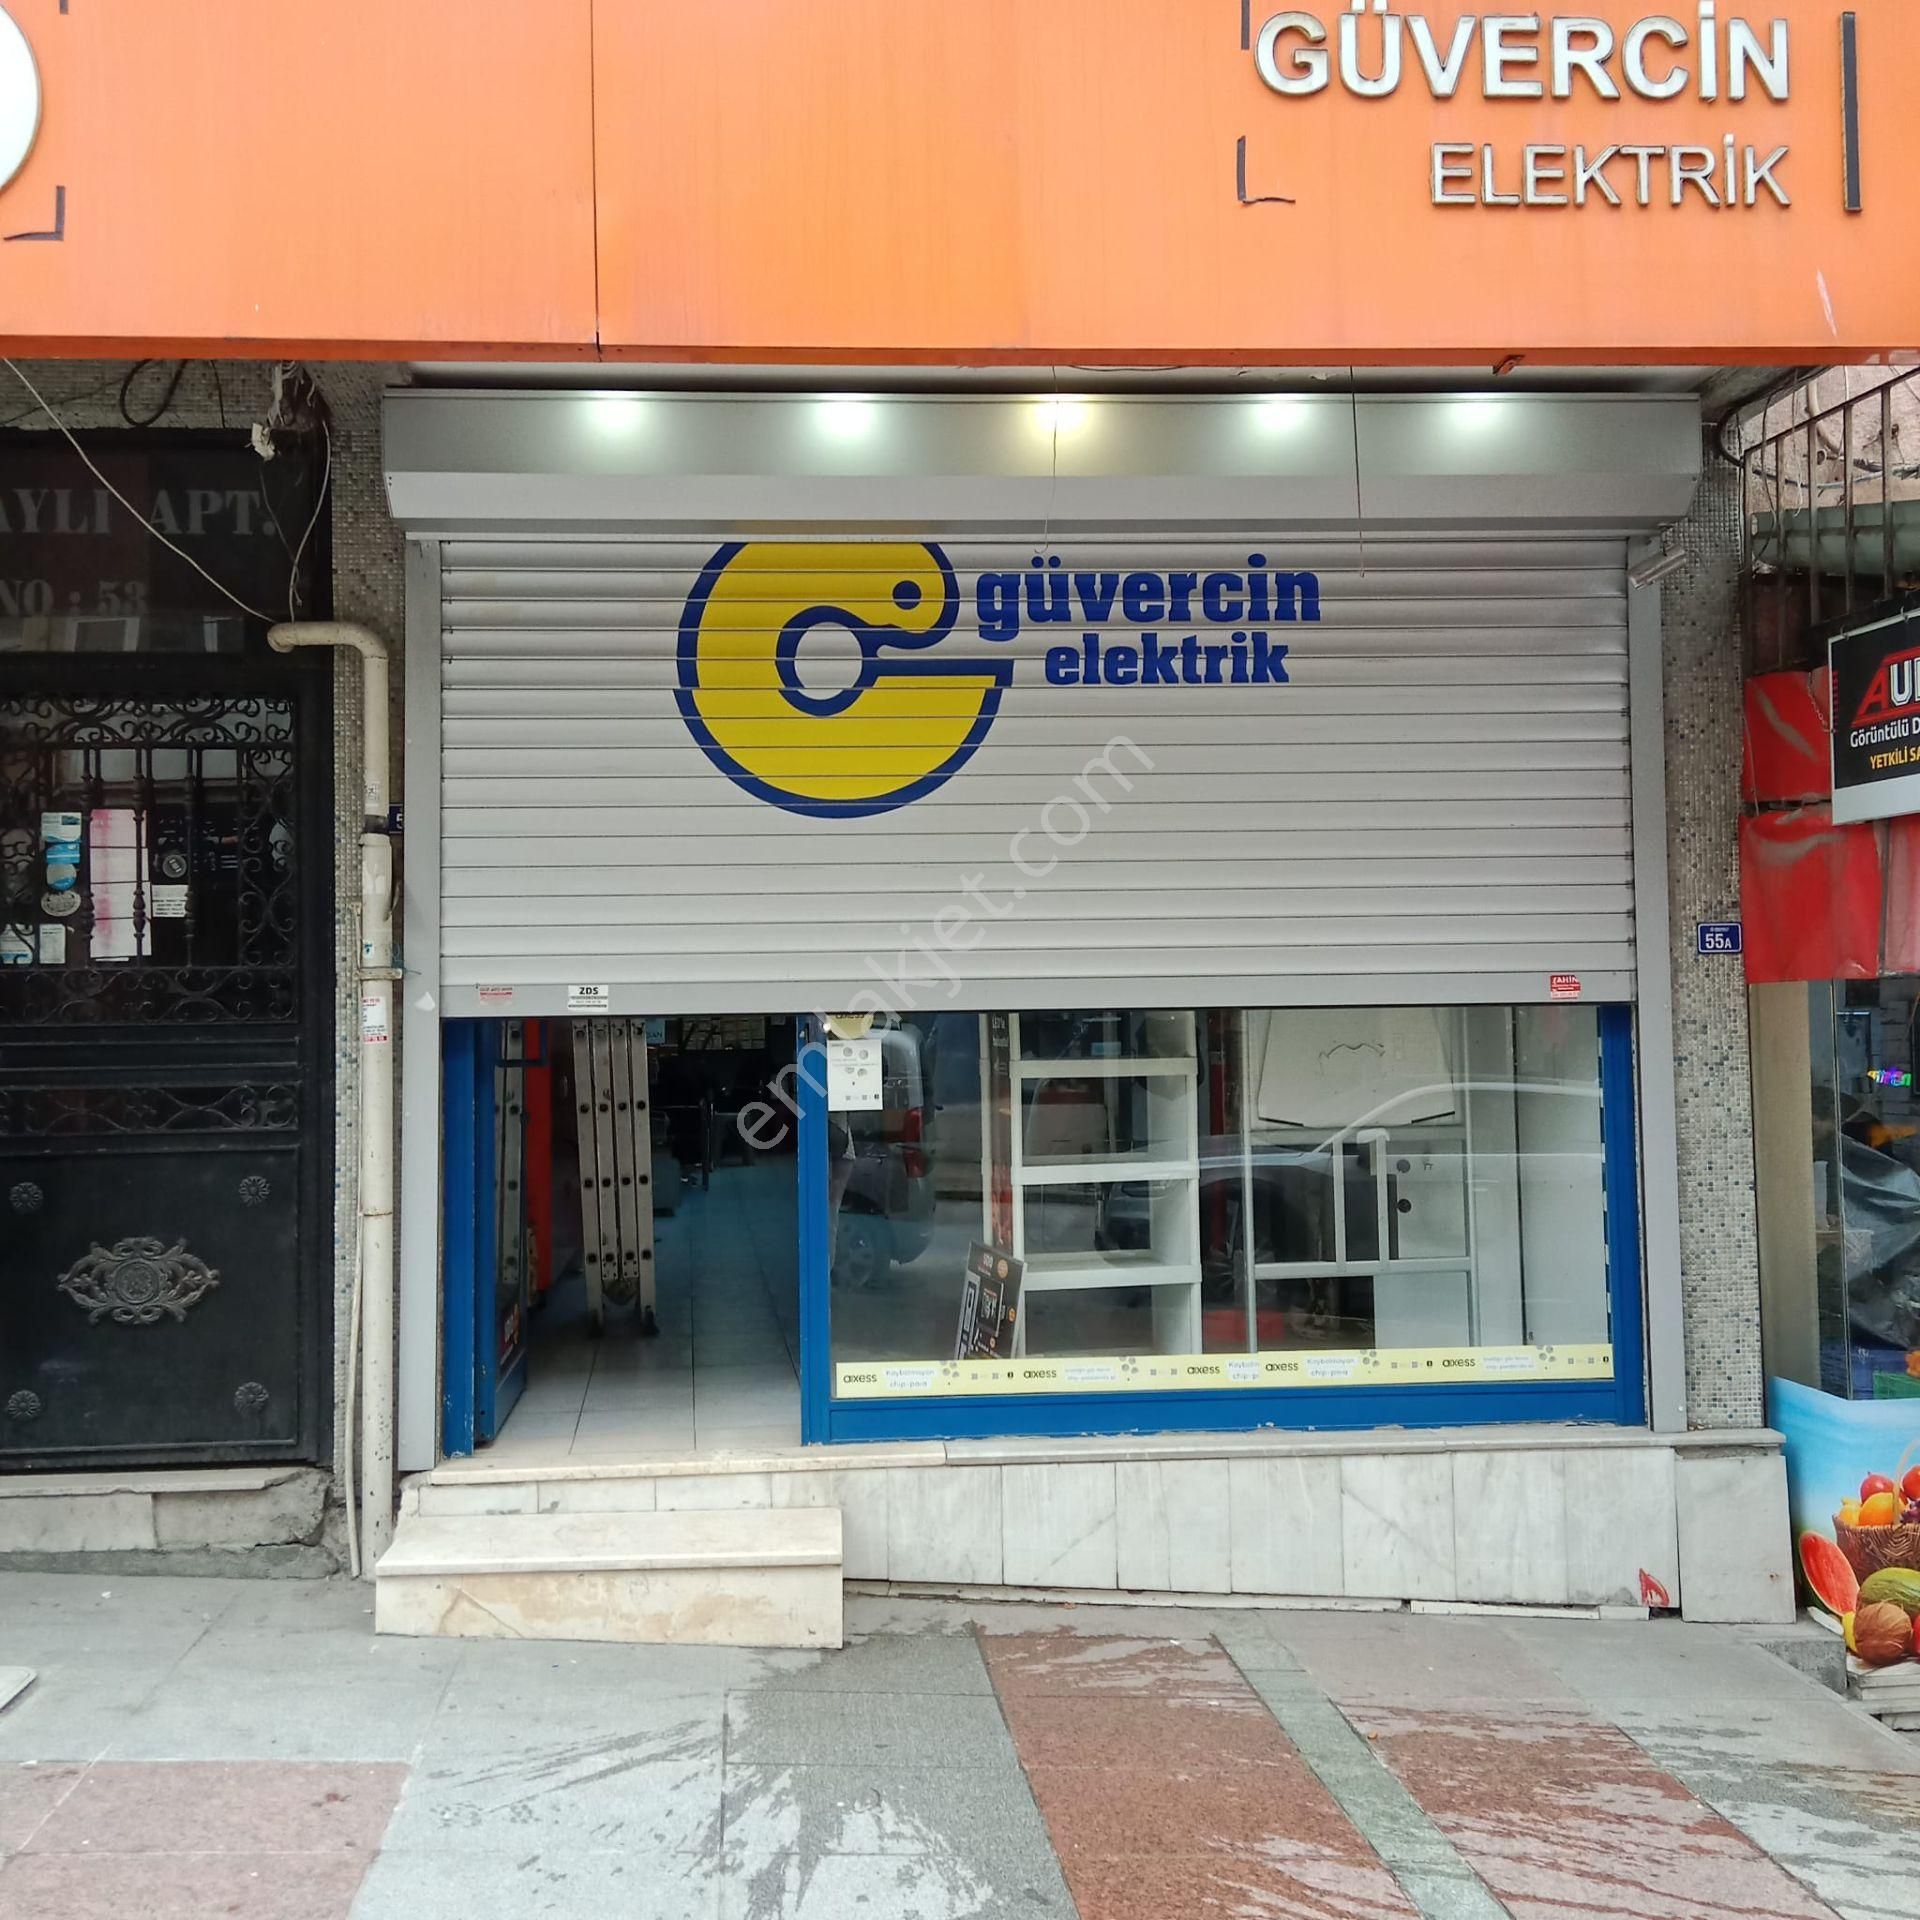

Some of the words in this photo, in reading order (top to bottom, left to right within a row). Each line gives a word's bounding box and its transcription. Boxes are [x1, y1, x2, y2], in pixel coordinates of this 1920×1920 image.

[1255, 0, 1790, 101] GÜVERCİN
[1430, 133, 1791, 207] ELEKTRİK
[149, 489, 277, 536] APT.
[976, 553, 1321, 642] güvercin
[1045, 631, 1290, 686] elektrik
[1850, 717, 1909, 748] Görüntülü
[1869, 746, 1908, 770] YETKİLİ
[1705, 932, 1732, 949] 55A
[579, 986, 599, 995] ZDS
[1187, 1365, 1221, 1375] axess
[1265, 1361, 1299, 1372] axess
[1442, 1357, 1476, 1368] axess
[843, 1373, 878, 1384] axess
[1023, 1369, 1057, 1379] axess
